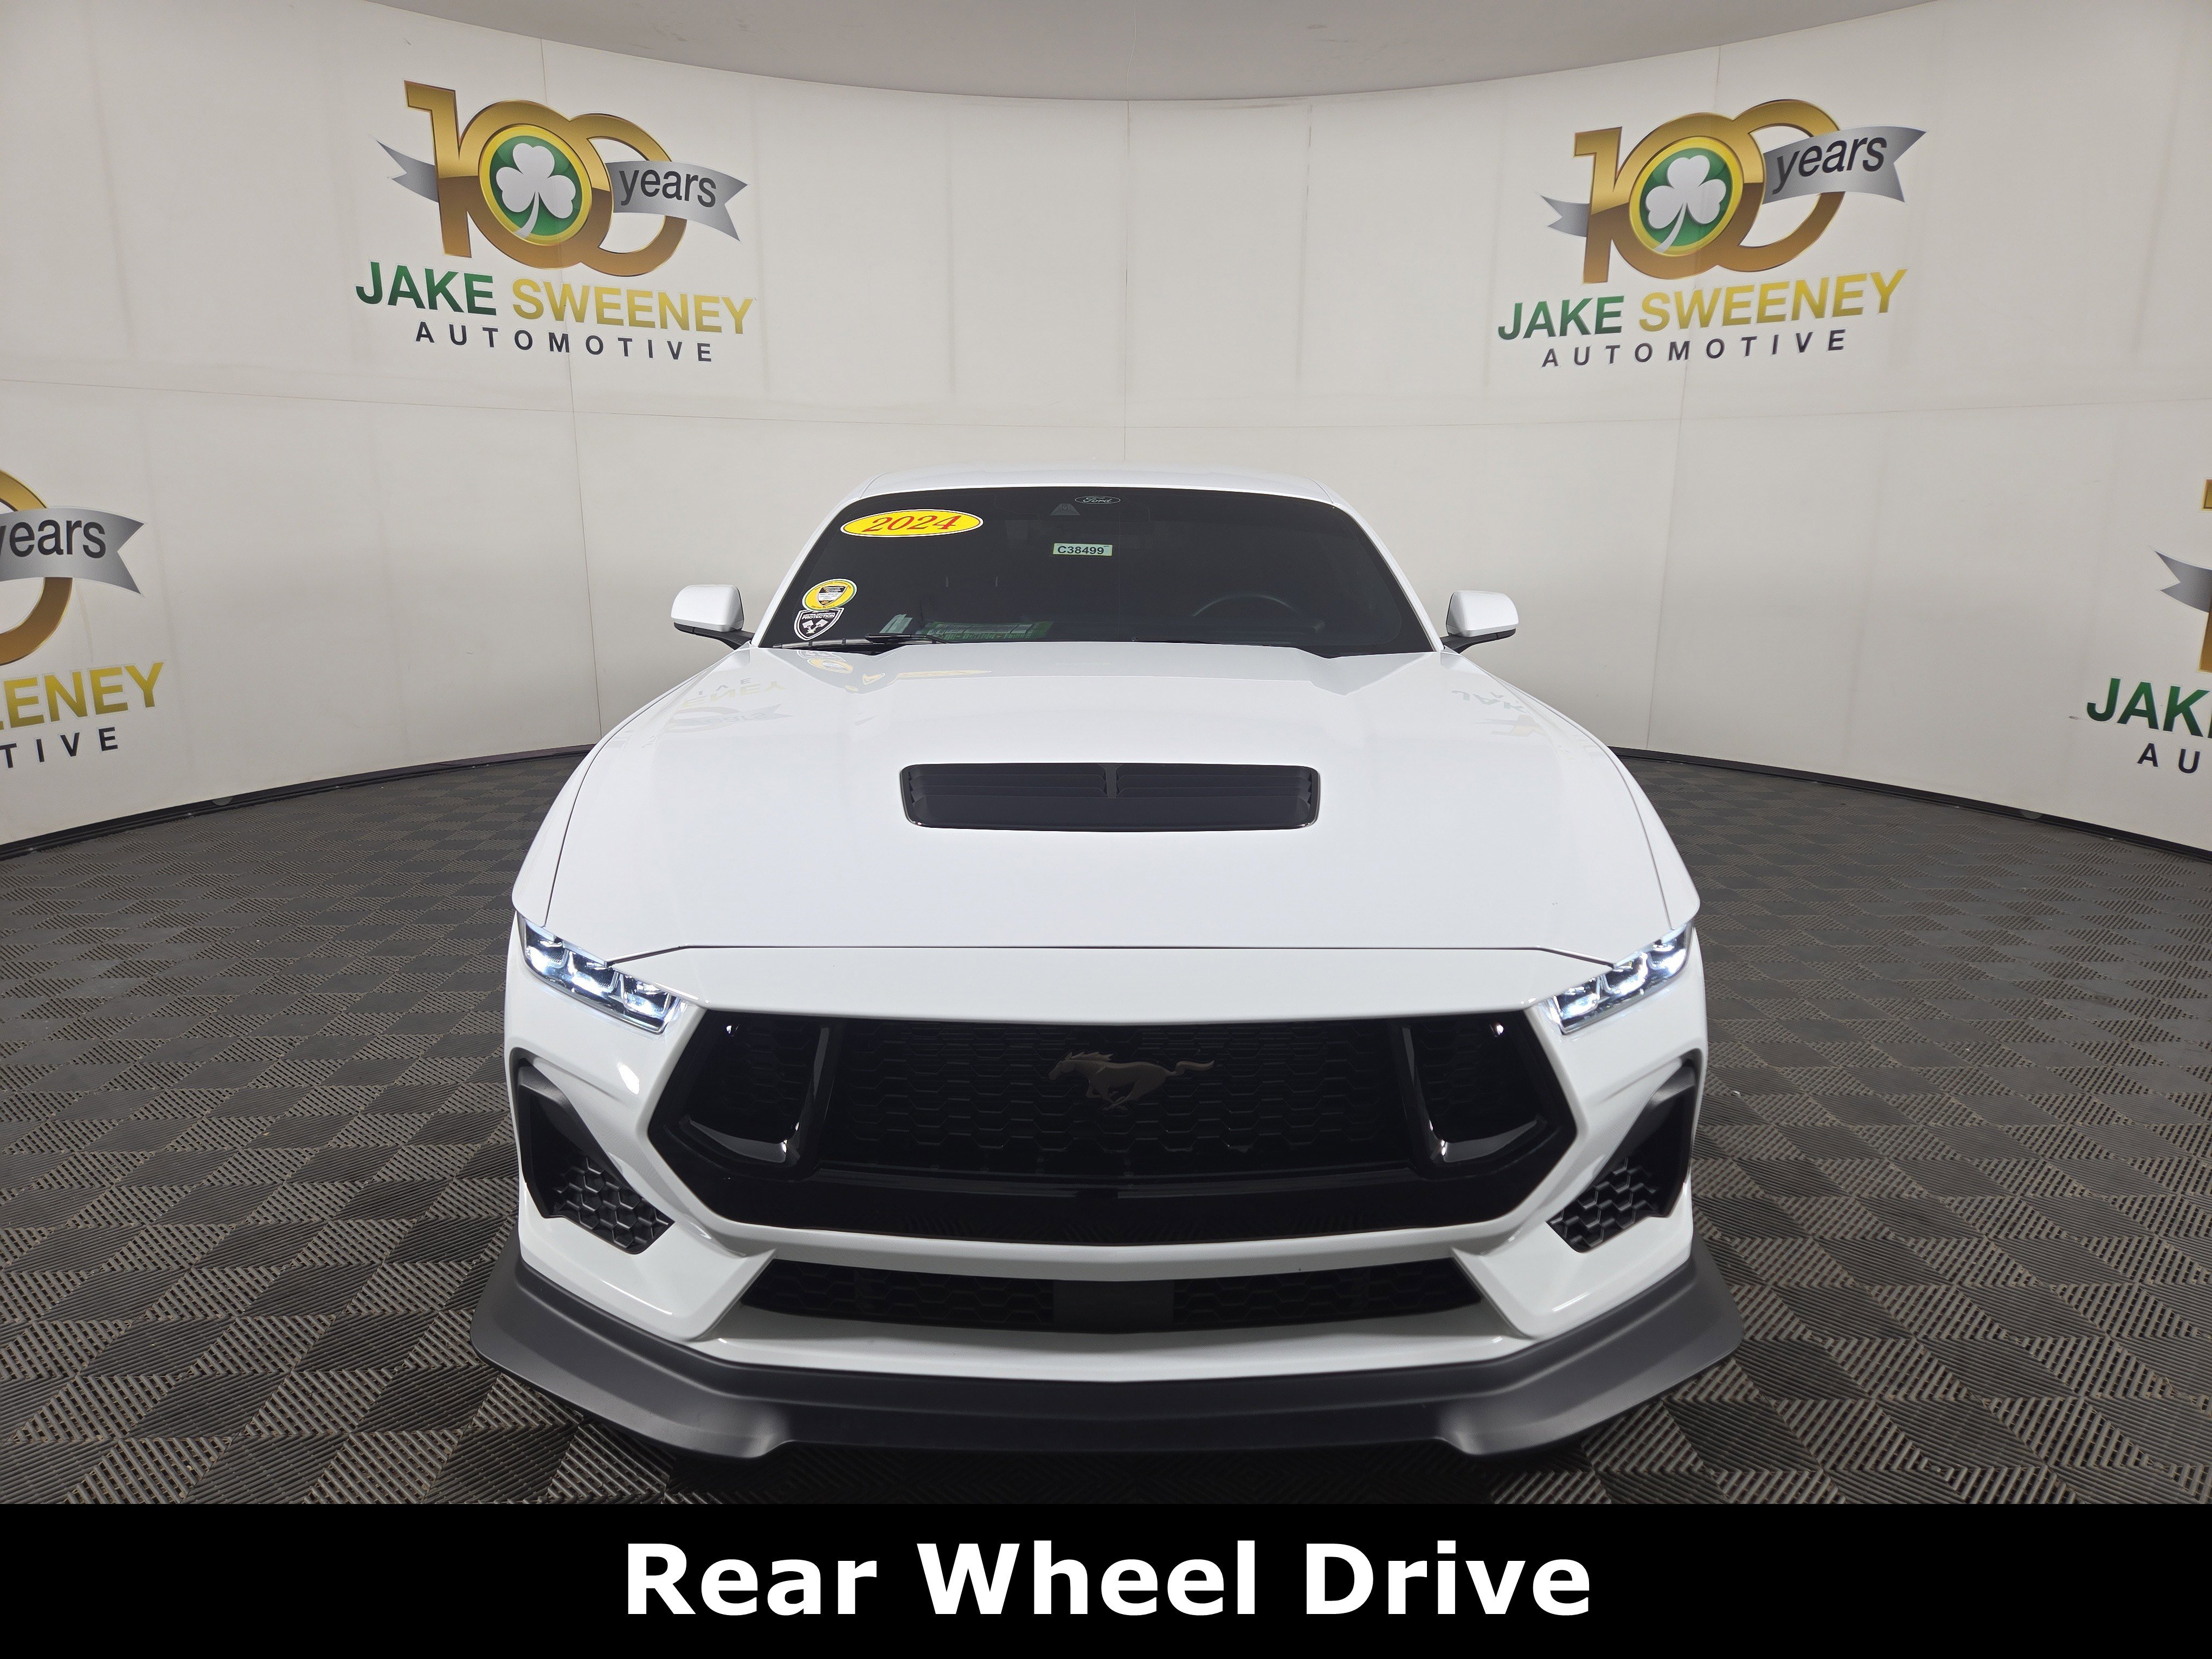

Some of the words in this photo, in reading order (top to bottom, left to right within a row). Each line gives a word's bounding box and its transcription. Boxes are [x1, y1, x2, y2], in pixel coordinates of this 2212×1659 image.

[404, 80, 687, 277] 100
[619, 169, 717, 208] years
[1573, 99, 1846, 284] 100
[1771, 136, 1888, 196] years
[356, 261, 497, 316] JAKE
[512, 278, 754, 335] SWEENEY
[1498, 295, 1624, 340] JAKE
[1639, 269, 1907, 332] SWEENEY
[415, 321, 712, 362] AUTOMOTIVE
[1541, 329, 1846, 368] AUTOMOTIVE
[861, 515, 962, 532] 2024
[1057, 545, 1104, 555] C38499
[0, 661, 164, 730] ENEY
[2087, 678, 2212, 739] JAK
